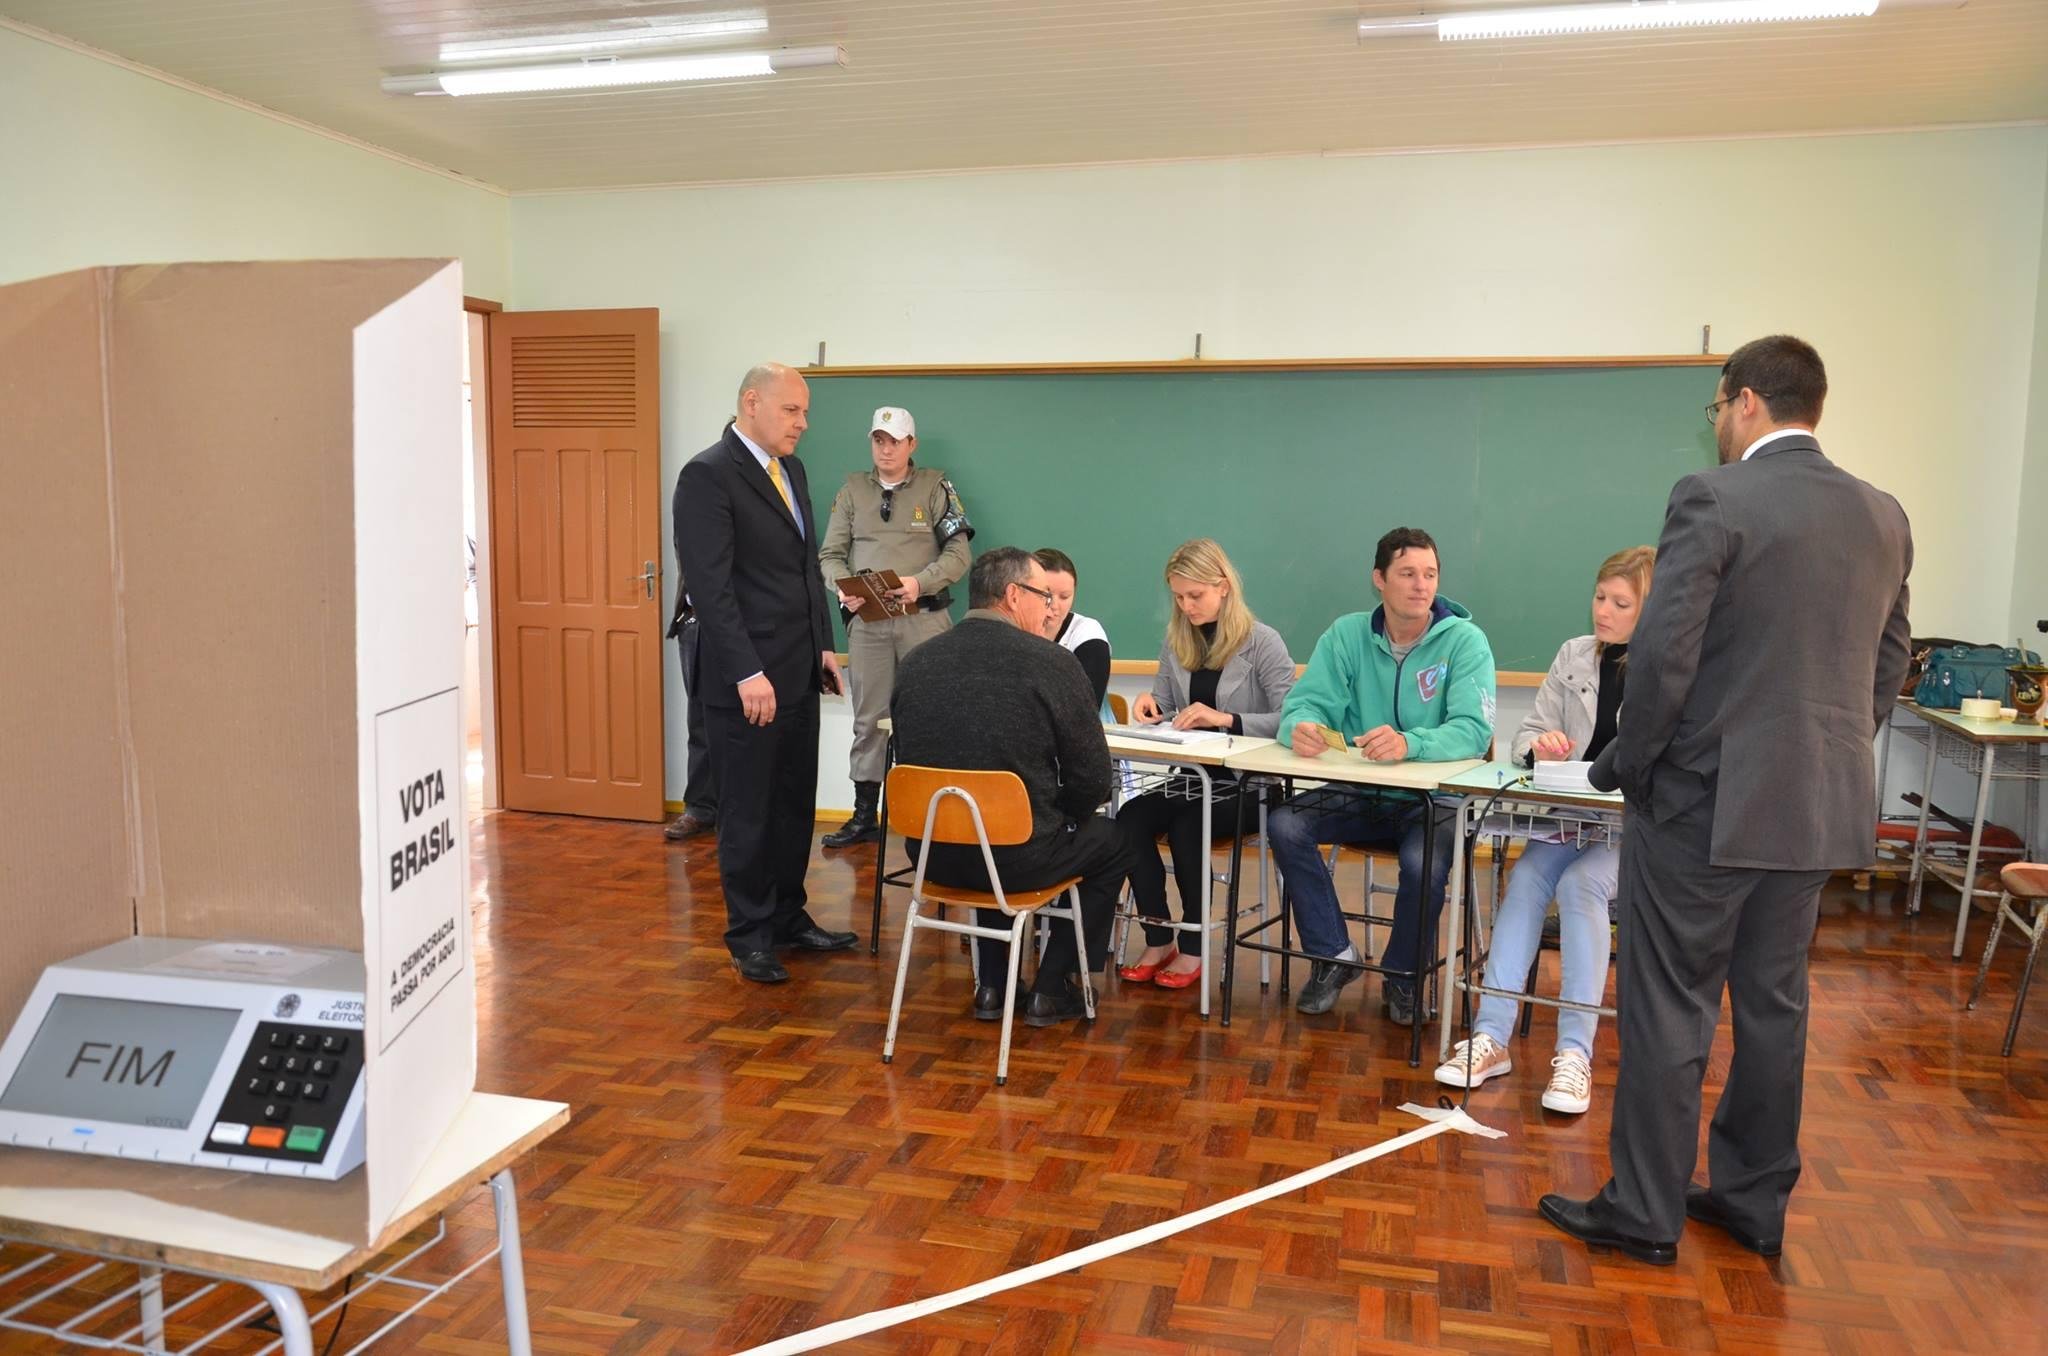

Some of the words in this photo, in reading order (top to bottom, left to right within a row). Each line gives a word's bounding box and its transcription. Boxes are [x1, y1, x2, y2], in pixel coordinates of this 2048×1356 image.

[399, 768, 445, 824] VOTA
[390, 818, 455, 892] BRASIL
[391, 969, 398, 988] A
[401, 917, 455, 978] DEMOCRACIA
[391, 973, 419, 1013] PASSA
[420, 955, 436, 984] POR
[438, 937, 455, 966] AQUI
[318, 1010, 366, 1024] ELEITOR
[270, 1032, 278, 1042] 1
[296, 1034, 306, 1045] 2
[324, 1036, 333, 1047] 3
[65, 1041, 176, 1088] FIM
[259, 1055, 268, 1065] 4
[286, 1057, 296, 1068] 5
[313, 1060, 323, 1071] 6
[249, 1078, 258, 1088] 7
[275, 1080, 286, 1092] 8
[303, 1083, 313, 1094] 9
[265, 1104, 275, 1116] 0
